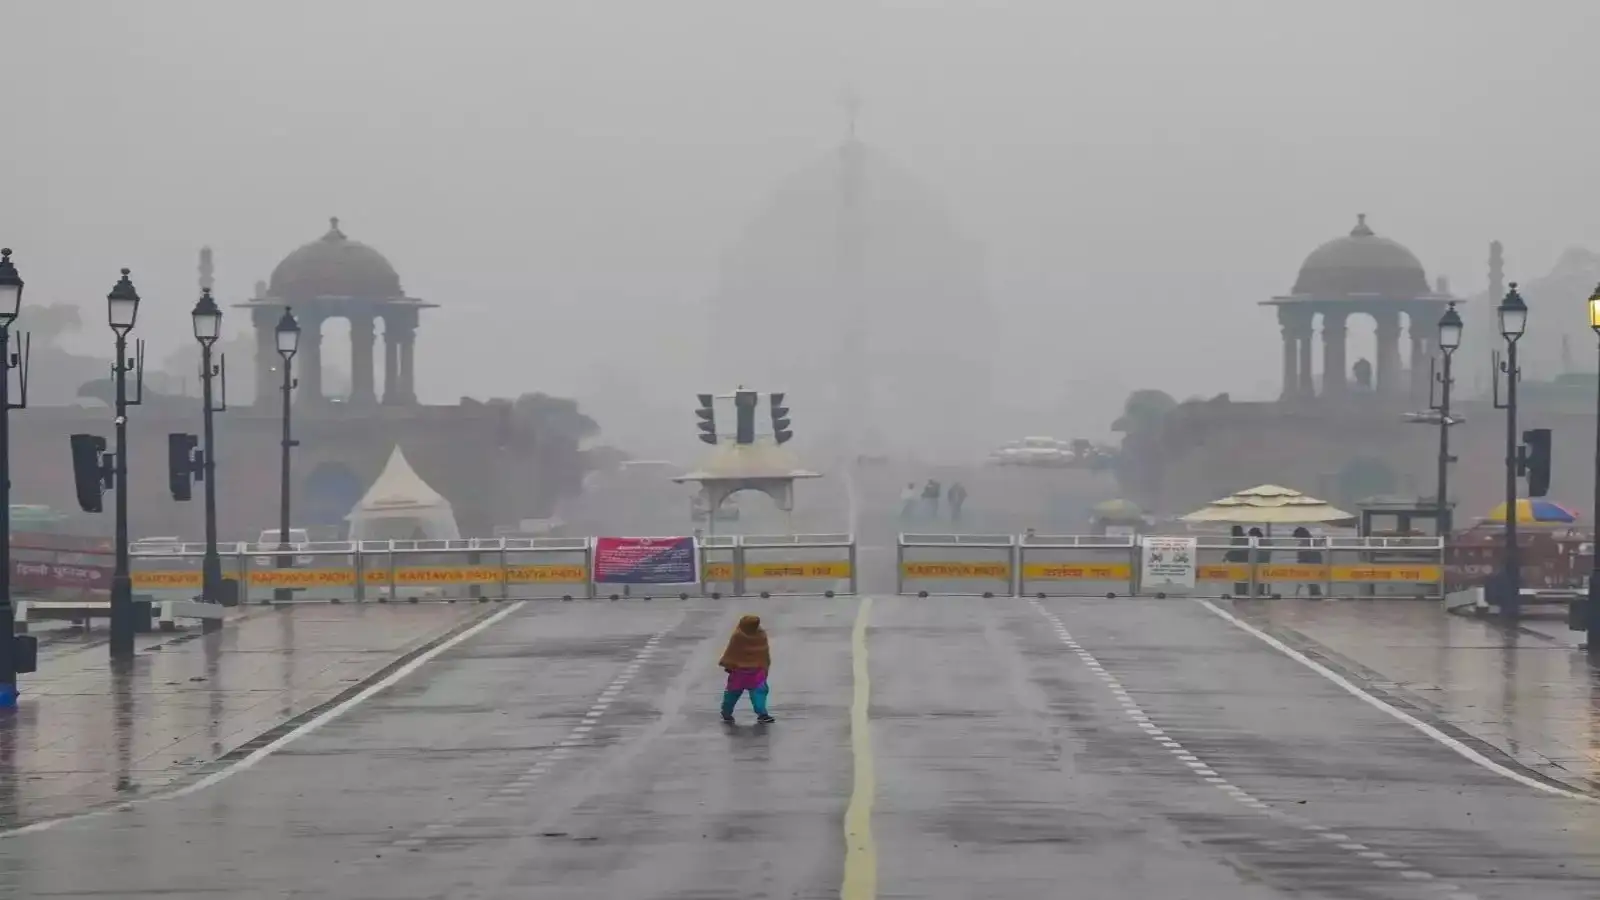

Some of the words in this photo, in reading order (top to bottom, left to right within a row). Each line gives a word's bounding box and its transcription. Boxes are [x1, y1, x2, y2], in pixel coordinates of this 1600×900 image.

[399, 570, 463, 581] KARTAVYA
[551, 568, 581, 579] PATH
[907, 564, 971, 576] KARTAVYA
[319, 572, 350, 584] PATH
